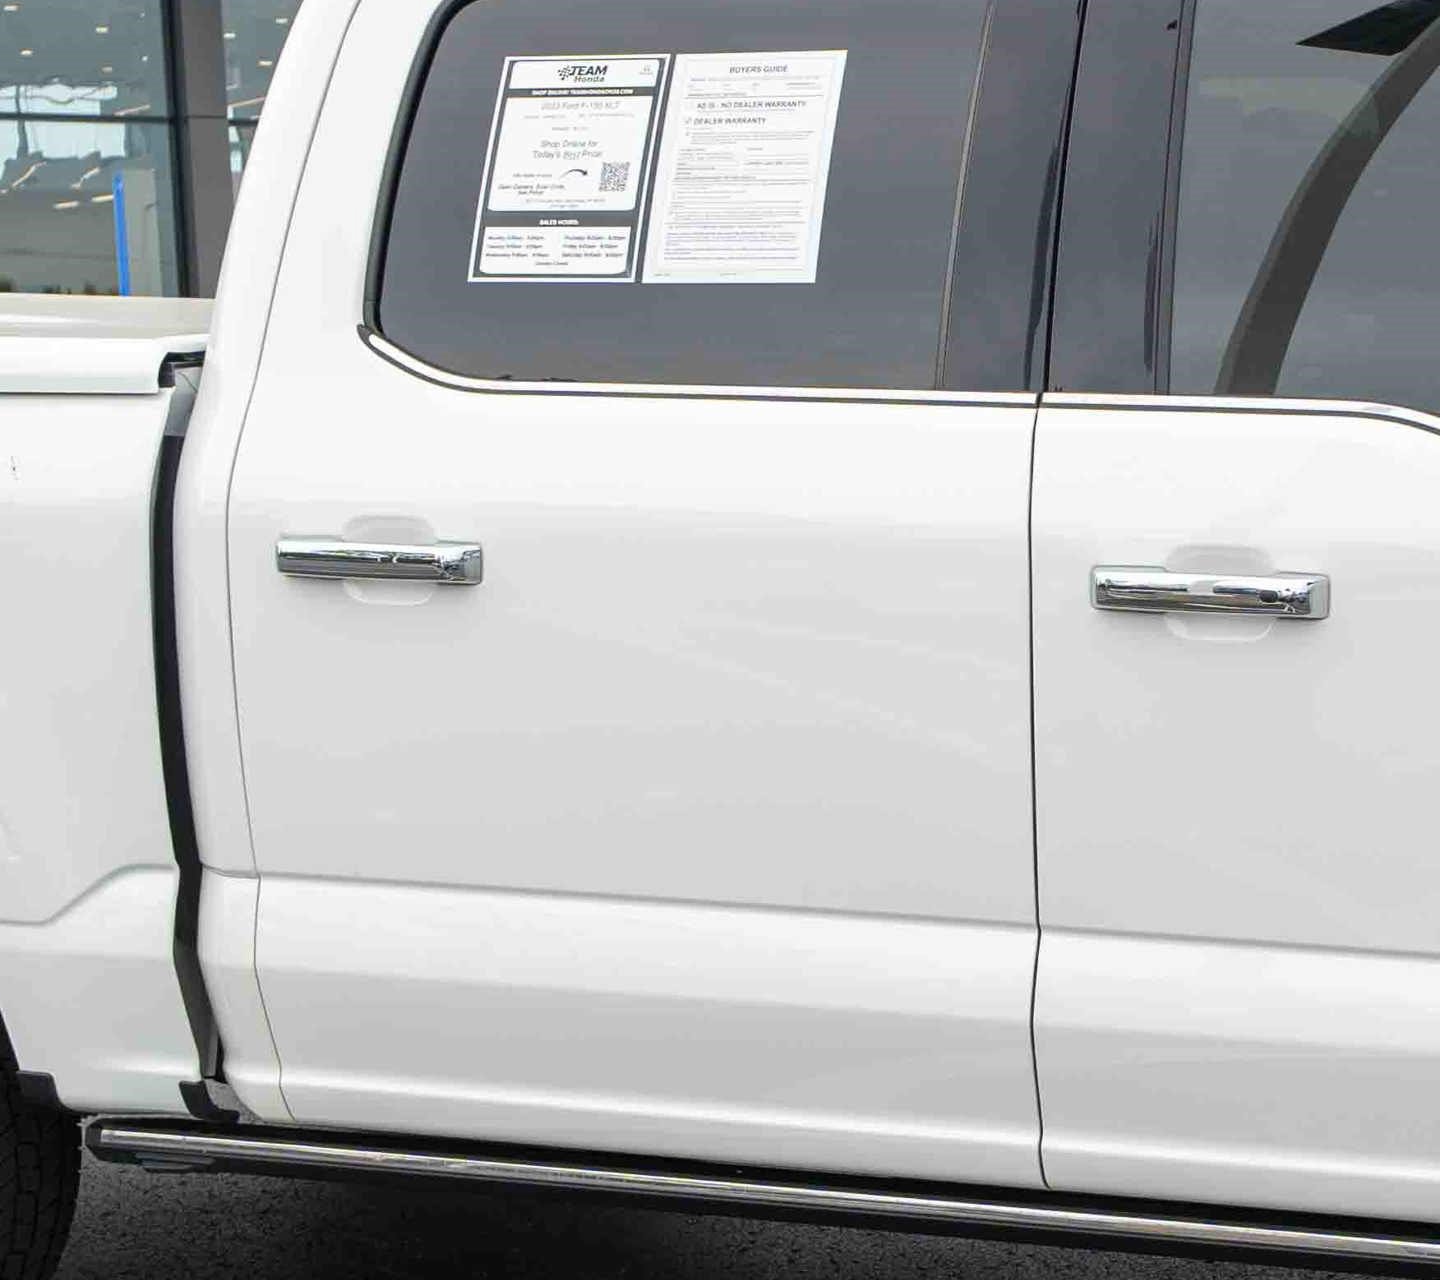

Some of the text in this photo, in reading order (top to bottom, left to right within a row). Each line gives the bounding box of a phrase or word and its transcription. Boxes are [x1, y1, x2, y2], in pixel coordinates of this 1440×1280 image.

[571, 65, 608, 76] TEAM
[763, 65, 788, 73] GUIDE
[574, 75, 605, 83] Honda
[725, 117, 767, 125] WARRANTY
